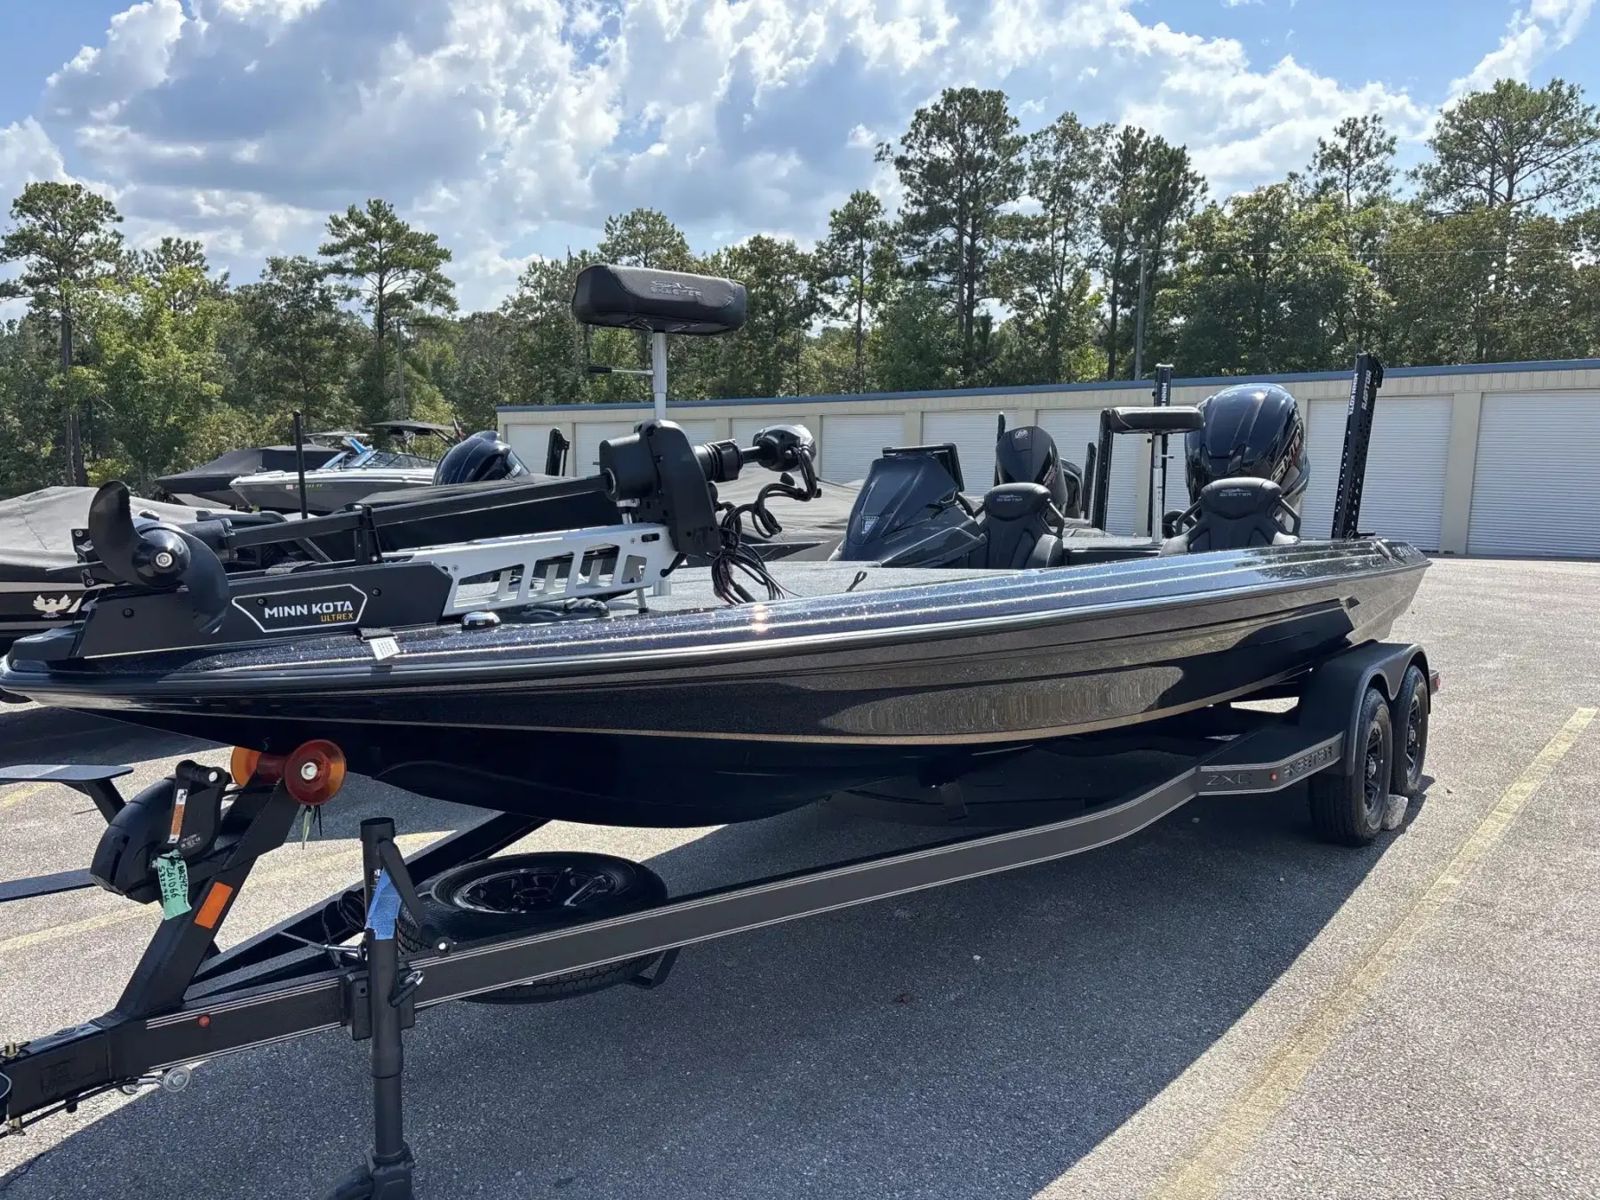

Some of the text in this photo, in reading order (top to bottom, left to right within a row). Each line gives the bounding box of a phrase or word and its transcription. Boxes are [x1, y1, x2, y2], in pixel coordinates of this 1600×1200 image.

[264, 600, 354, 619] MINN KOTA
[320, 612, 354, 622] ULTREX
